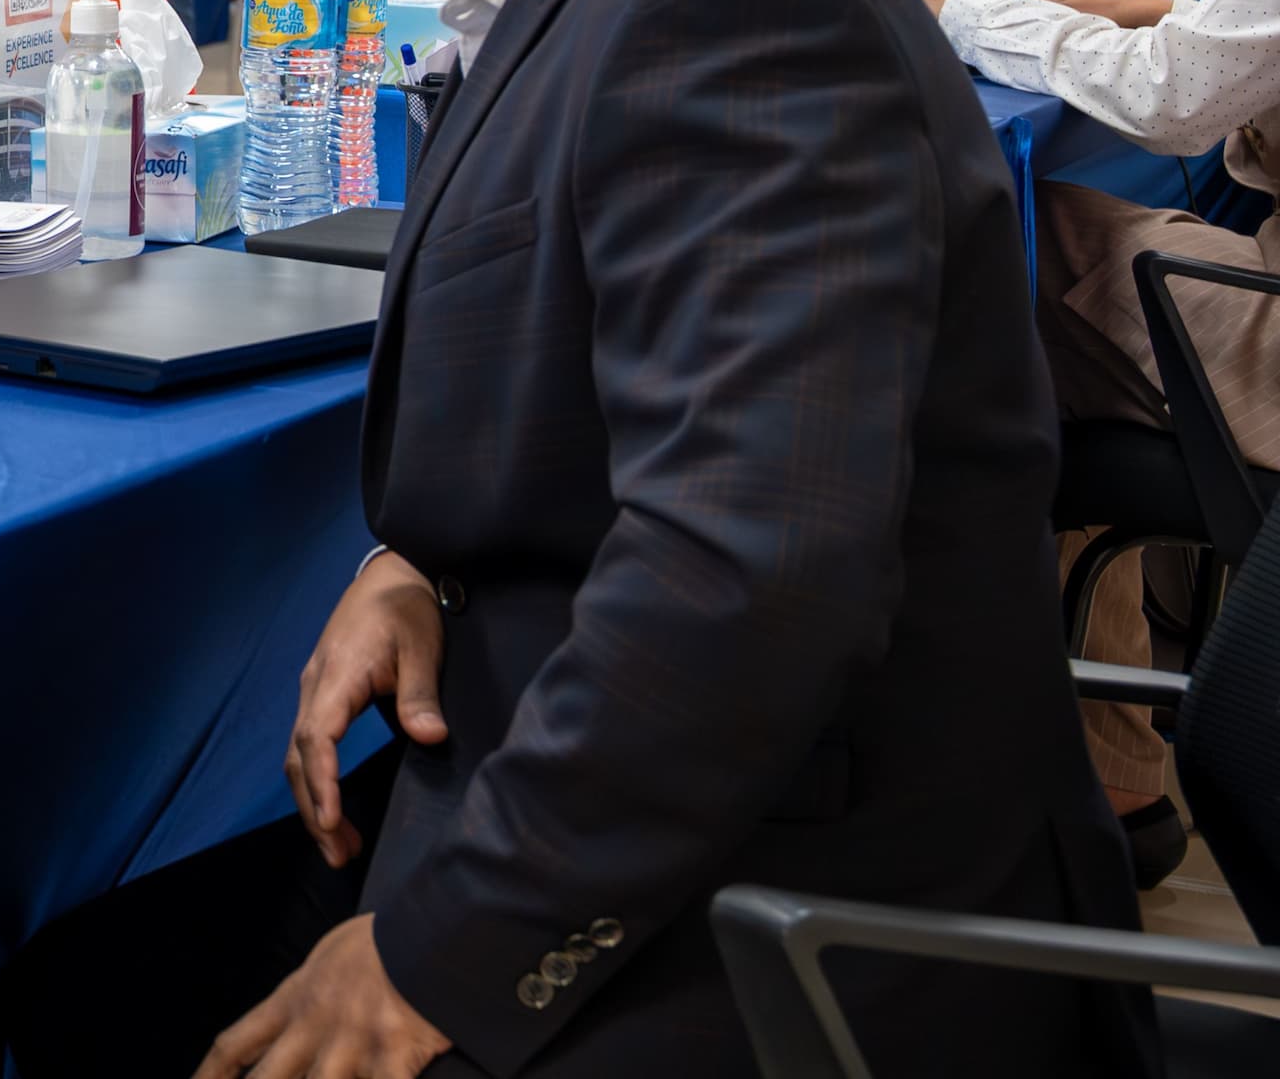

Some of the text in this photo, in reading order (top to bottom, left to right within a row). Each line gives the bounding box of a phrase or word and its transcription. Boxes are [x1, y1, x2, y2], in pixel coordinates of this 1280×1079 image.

[253, 0, 288, 24] Aqua
[5, 29, 53, 53] EXPERIENCE
[5, 49, 54, 78] EXCELLENCE
